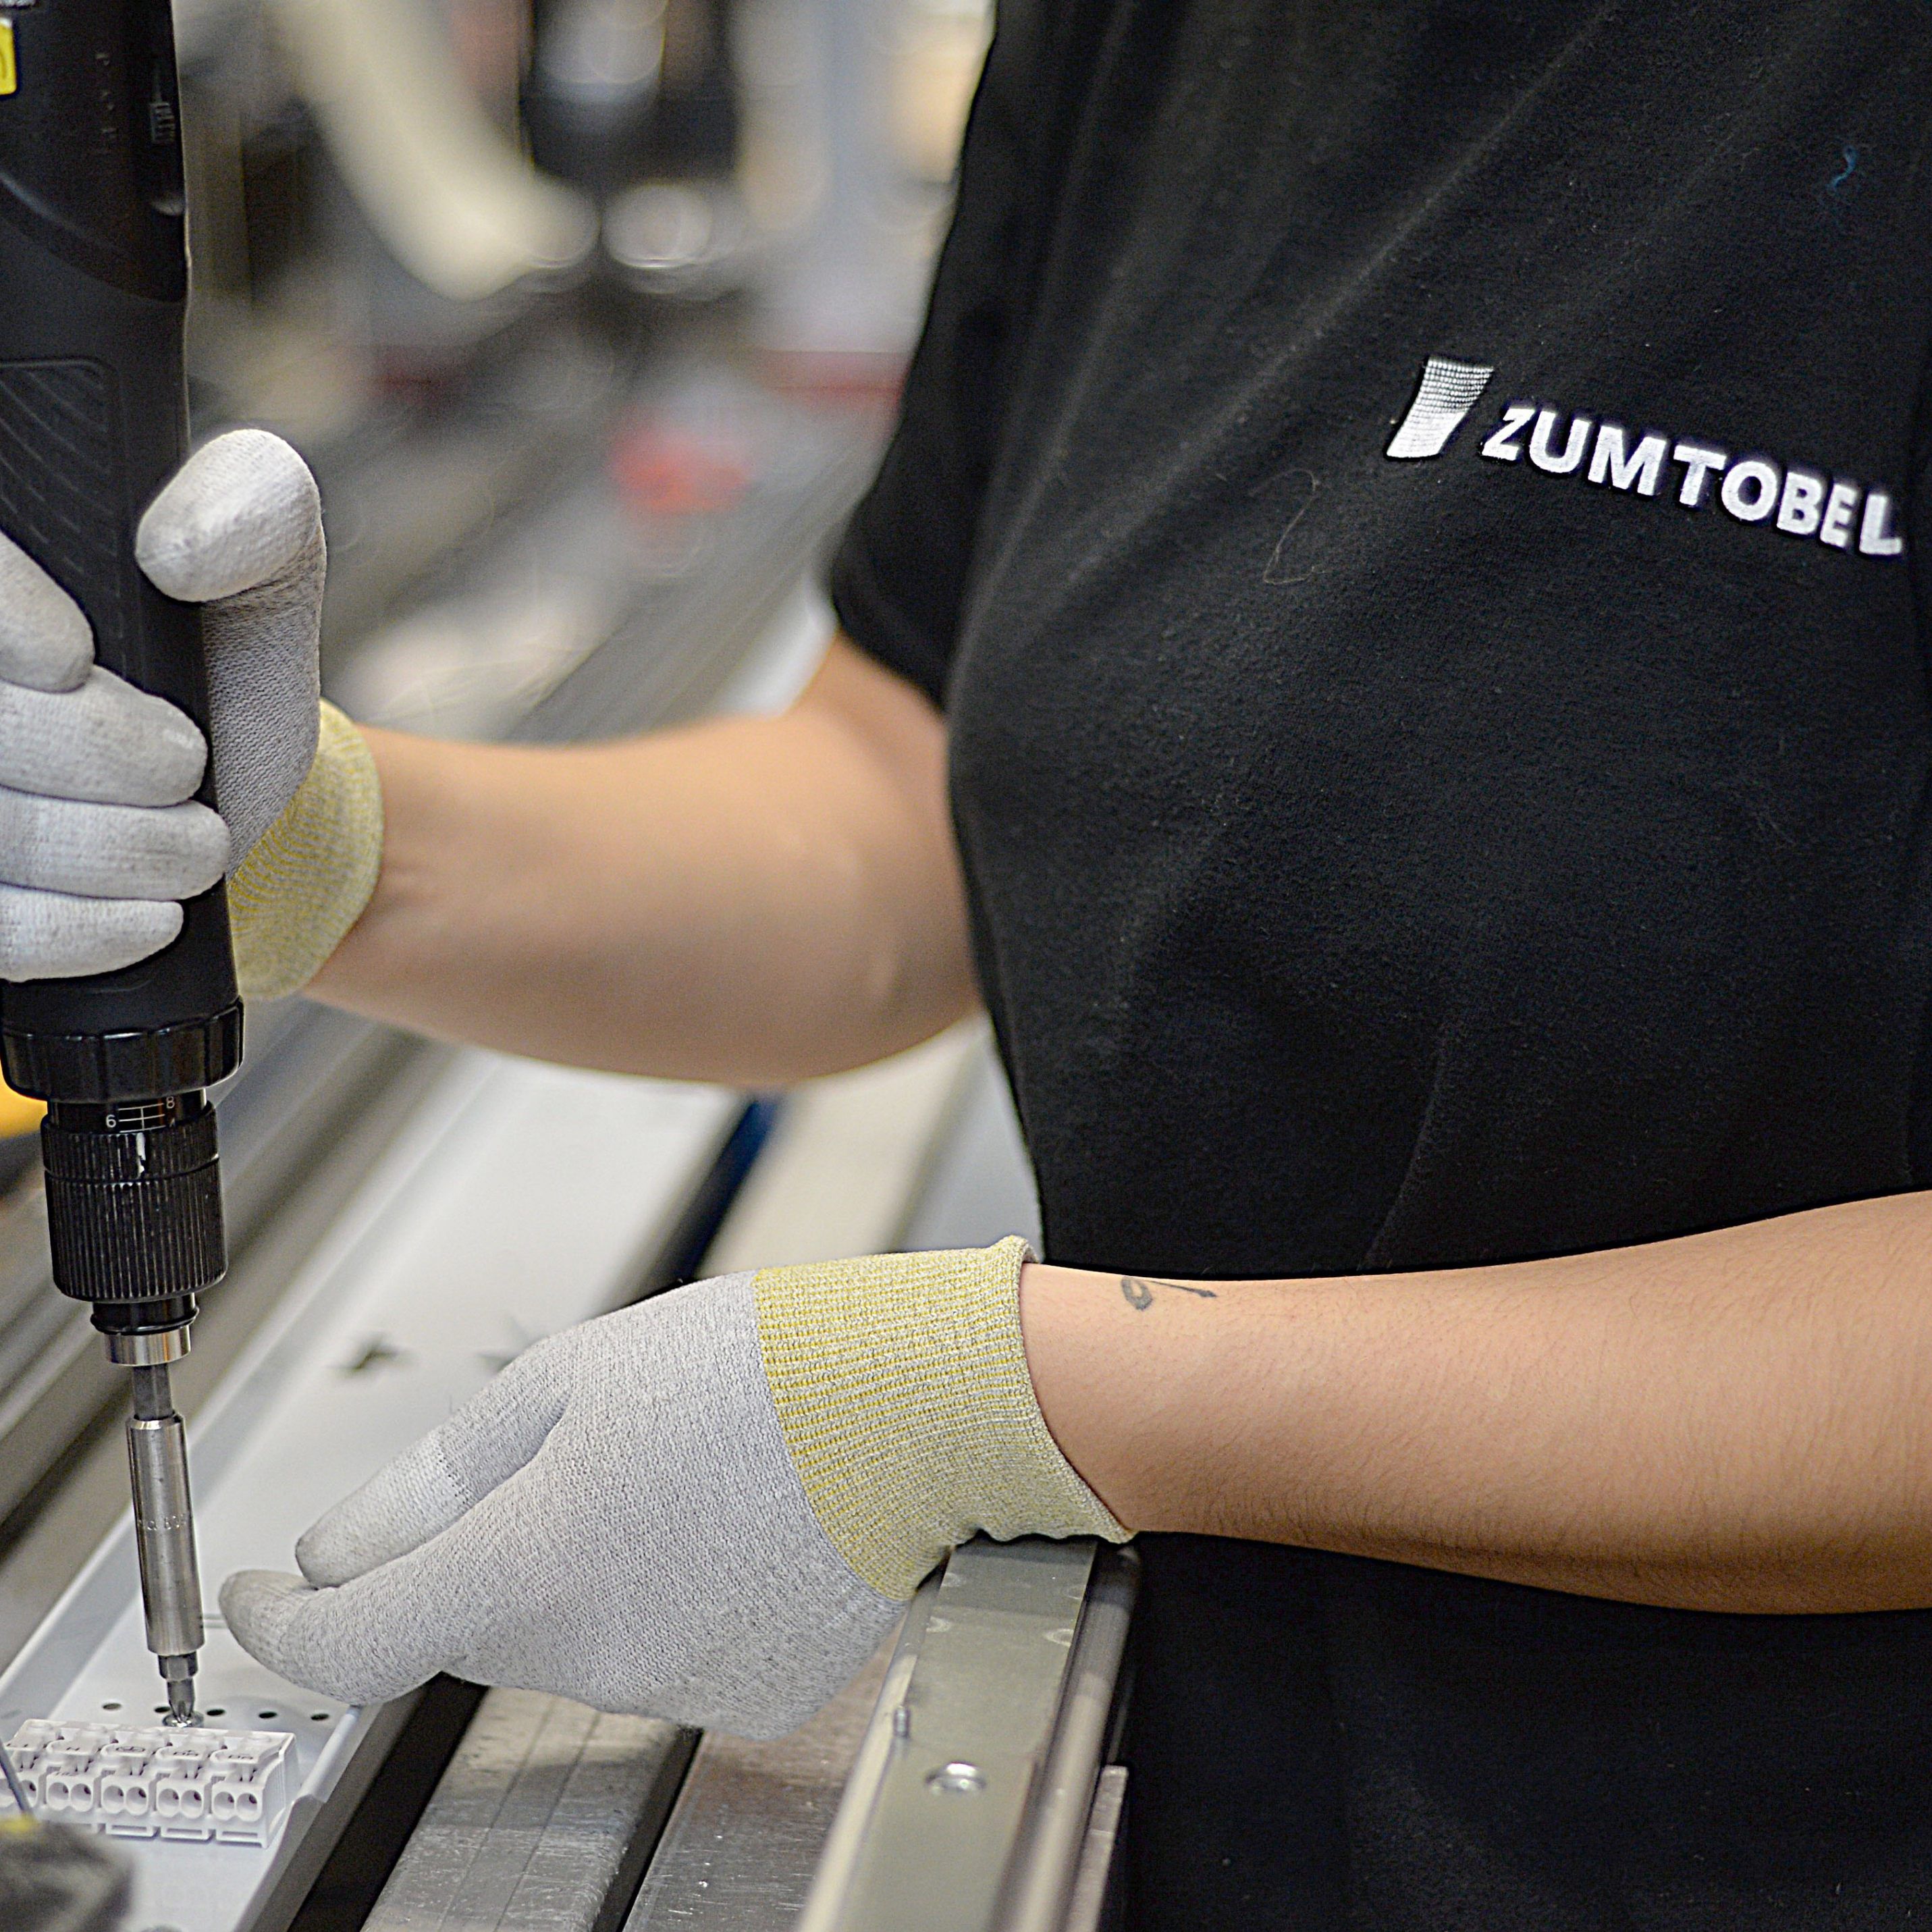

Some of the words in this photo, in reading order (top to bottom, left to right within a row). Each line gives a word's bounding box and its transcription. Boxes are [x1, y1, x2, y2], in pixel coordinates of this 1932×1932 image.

[1480, 406, 1903, 556] ZUMTOBEL
[166, 1096, 175, 1109] 8
[105, 1114, 117, 1128] 6
